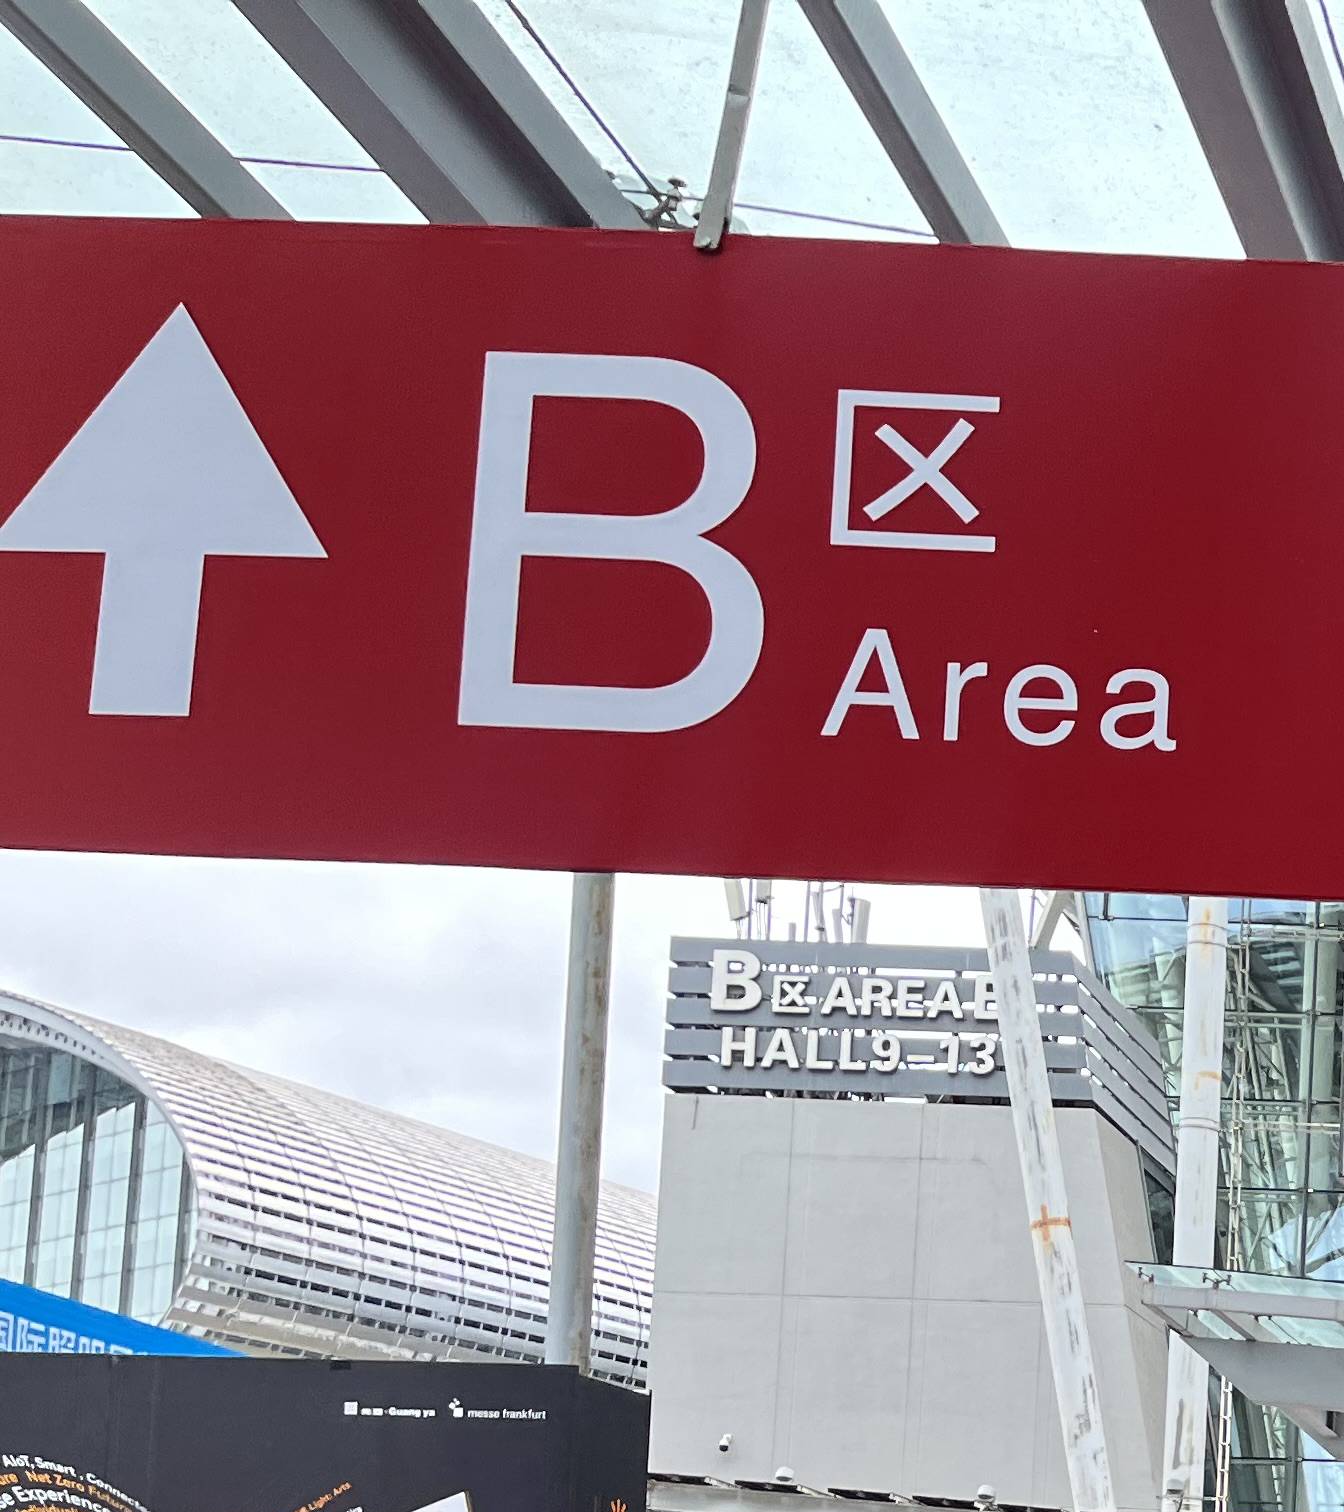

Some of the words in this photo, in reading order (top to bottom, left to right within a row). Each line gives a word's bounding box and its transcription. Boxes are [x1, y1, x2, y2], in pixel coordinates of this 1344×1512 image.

[458, 351, 764, 732] B
[830, 389, 1000, 552] 区
[821, 627, 1177, 752] Area
[710, 948, 763, 1012] B
[771, 975, 811, 1014] 区
[502, 1408, 547, 1420] frankfurt
